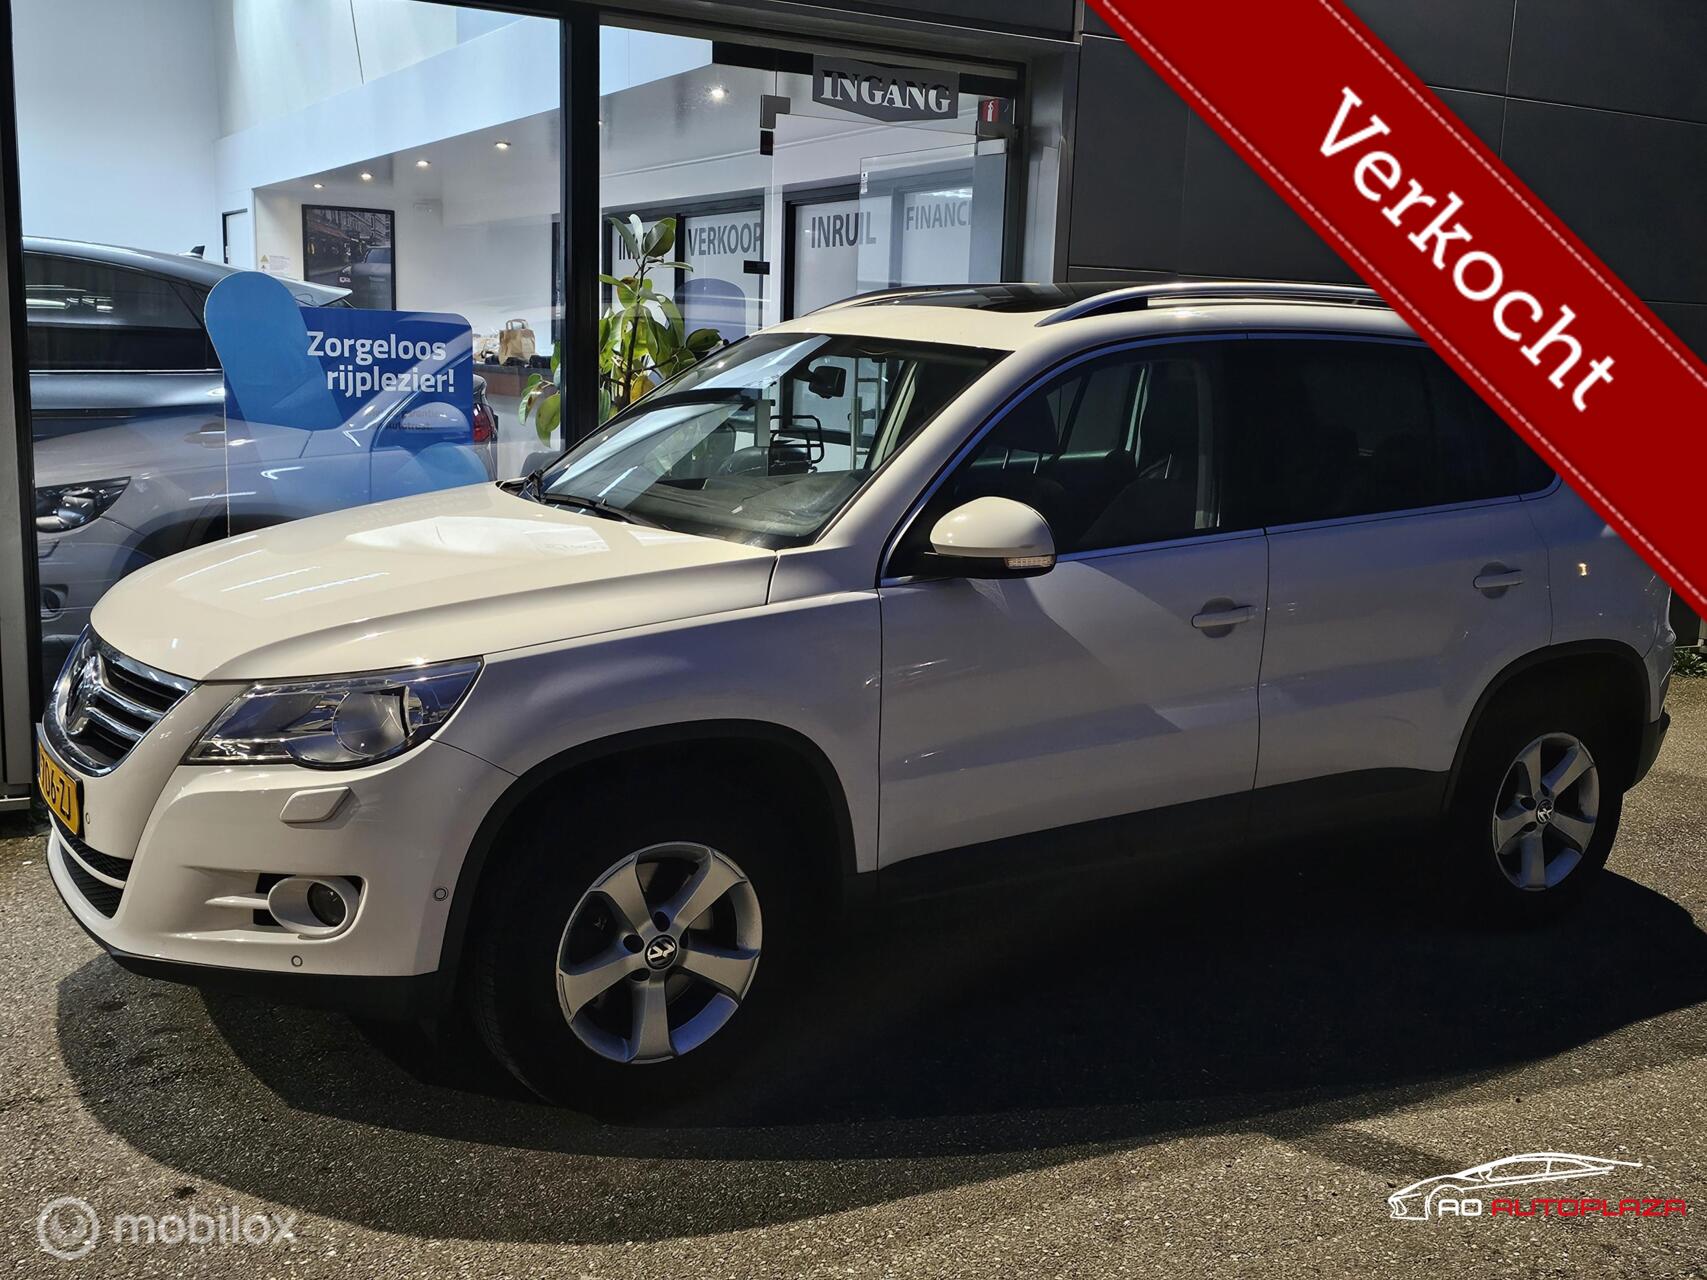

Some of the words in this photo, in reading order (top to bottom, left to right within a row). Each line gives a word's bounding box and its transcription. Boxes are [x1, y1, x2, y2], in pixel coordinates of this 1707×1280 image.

[820, 69, 952, 114] INGANG
[810, 211, 878, 249] INRUIL
[905, 200, 971, 231] FINANC
[687, 222, 762, 257] VERKOOP
[305, 330, 447, 366] Zorgeloos
[326, 365, 455, 398] rijplezier!
